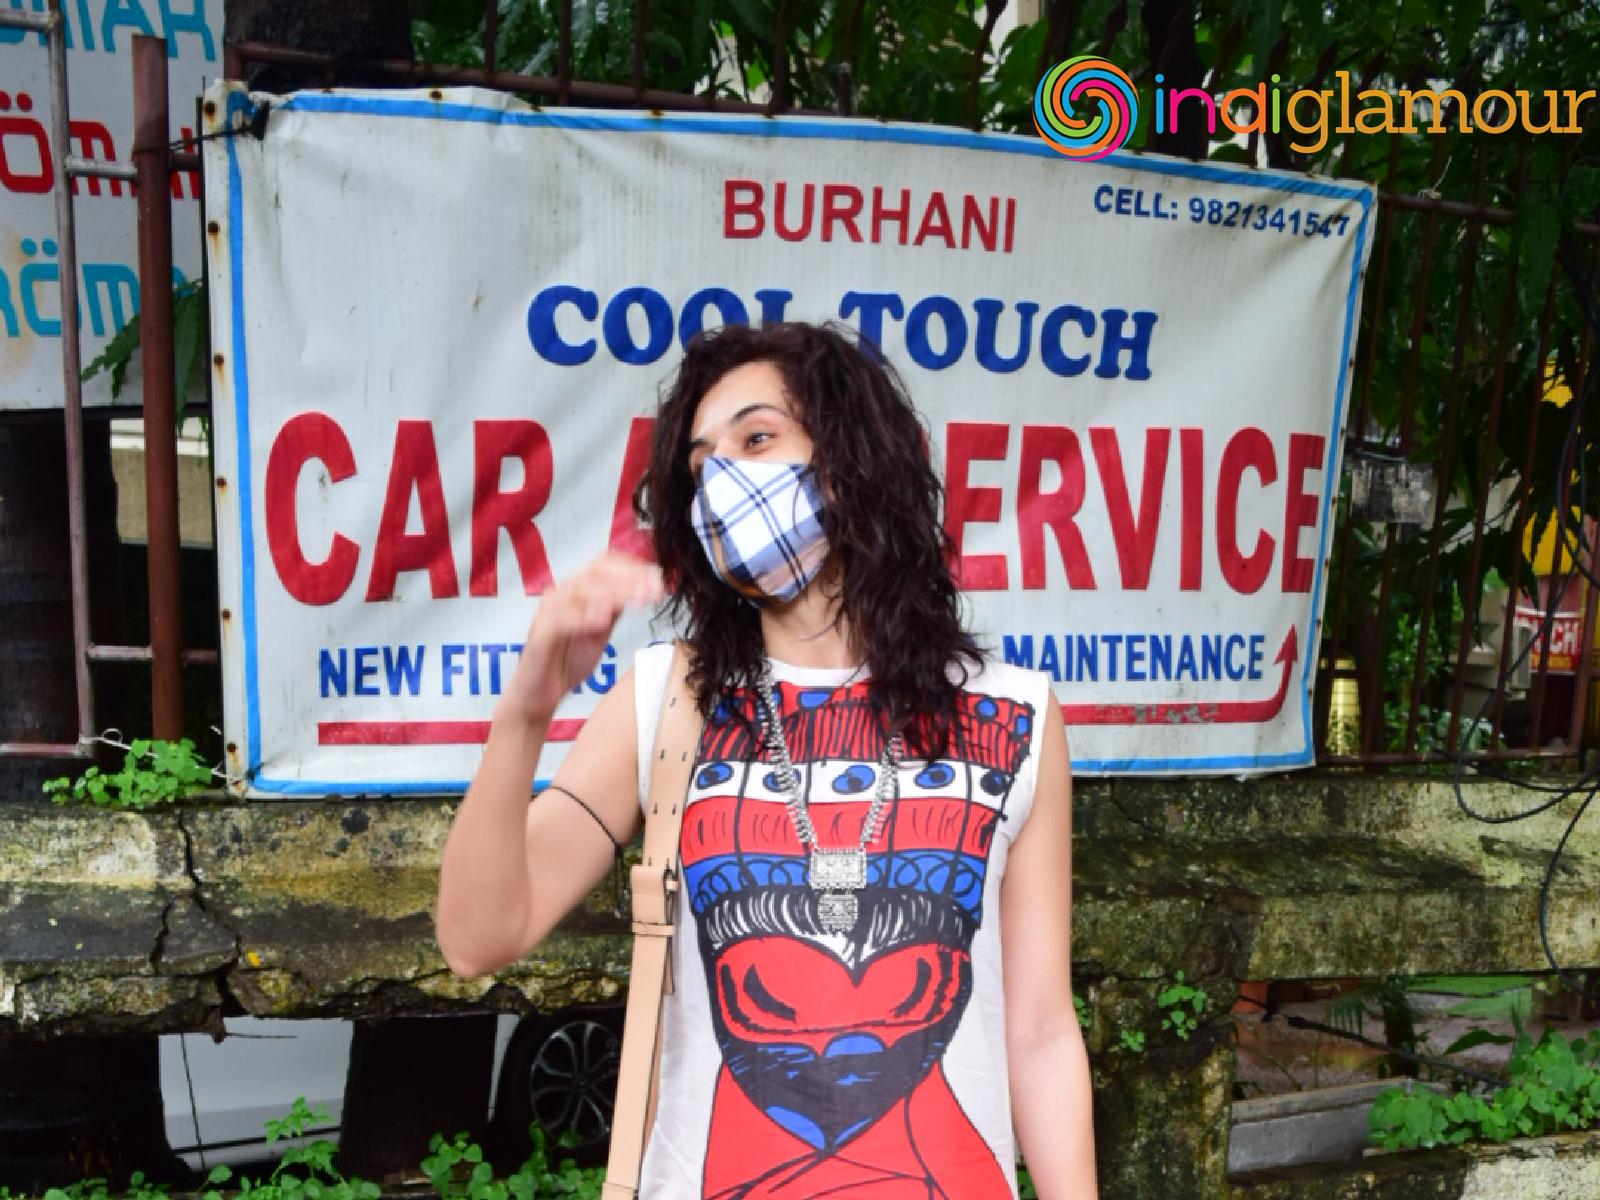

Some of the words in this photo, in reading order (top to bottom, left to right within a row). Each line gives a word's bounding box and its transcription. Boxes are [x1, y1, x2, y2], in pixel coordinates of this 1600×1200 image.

[723, 180, 1017, 253] BURHANI
[1094, 184, 1178, 220] CELL:
[1188, 198, 1350, 238] 9821341547
[839, 291, 1159, 380] TOUCH
[265, 411, 555, 606] CAR
[921, 421, 1326, 595] ERVICE
[319, 643, 426, 698] NEW
[441, 643, 618, 696] FITG
[1002, 633, 1265, 682] MAINTENANCE
